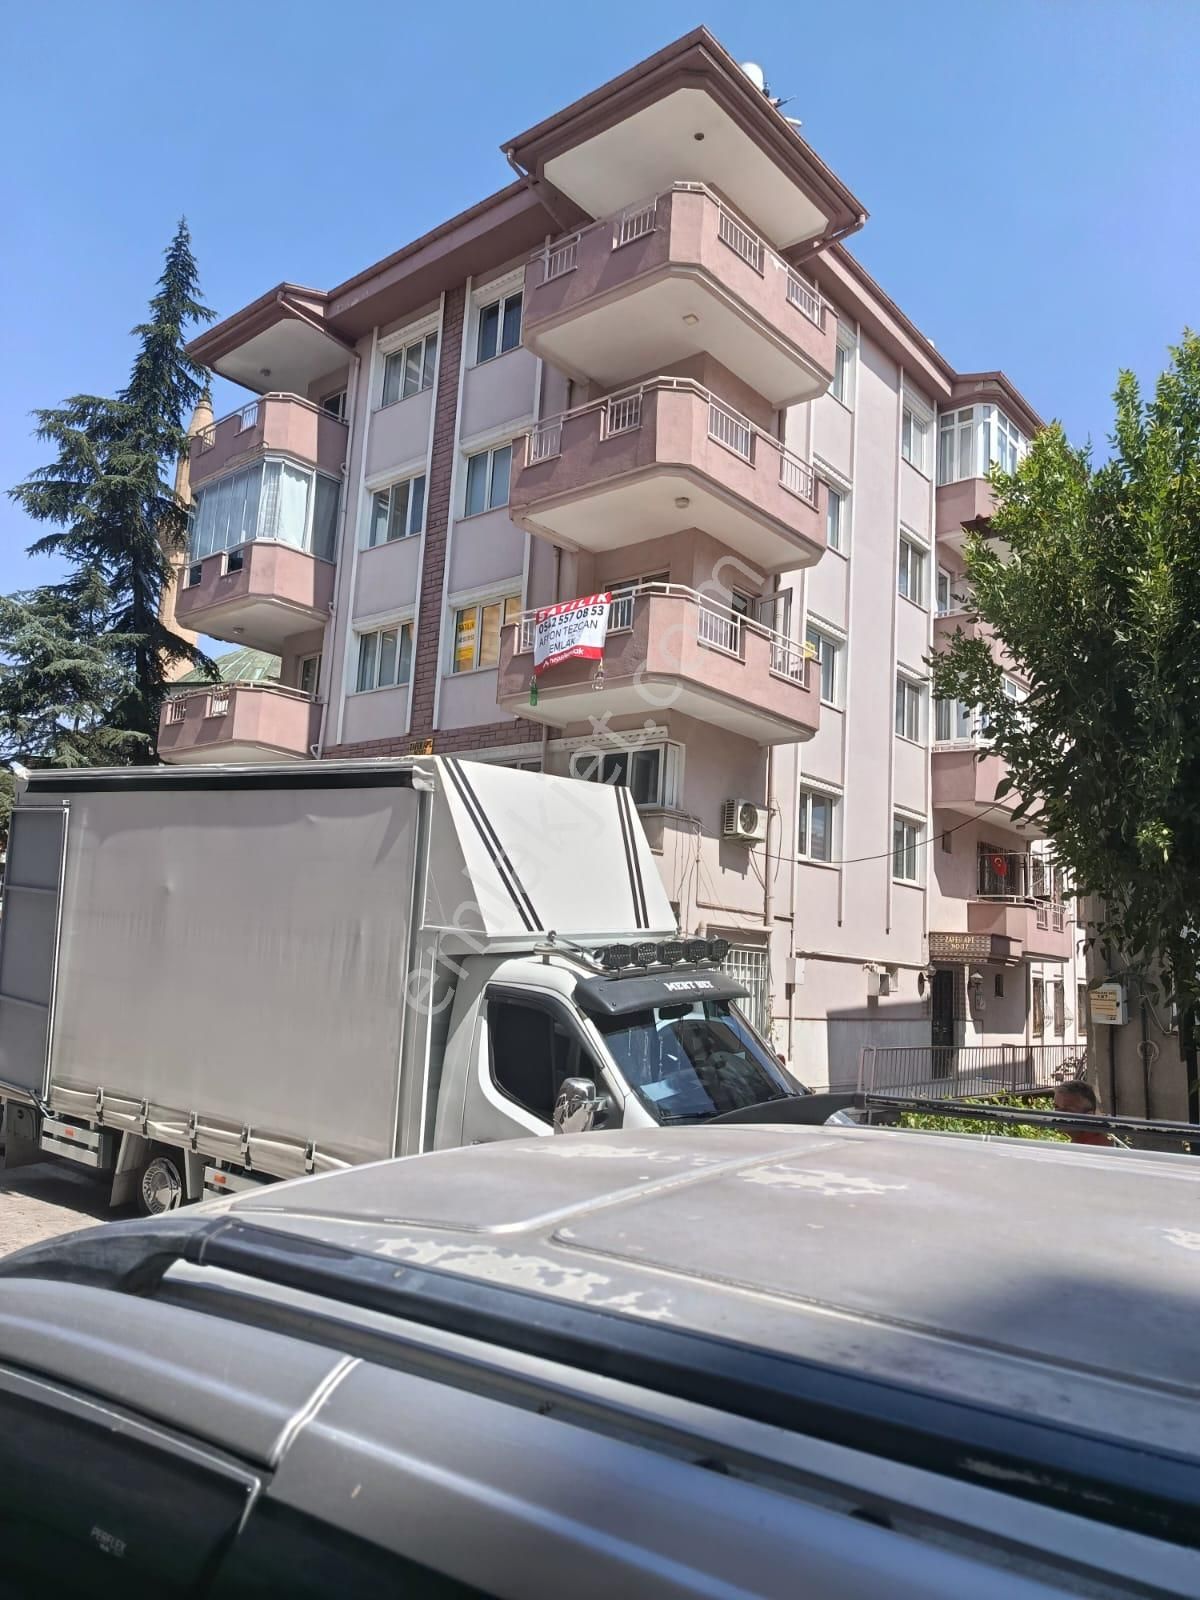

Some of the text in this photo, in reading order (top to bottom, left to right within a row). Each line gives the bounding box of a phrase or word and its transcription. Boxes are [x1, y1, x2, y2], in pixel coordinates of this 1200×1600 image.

[538, 593, 609, 621] SATILIK
[558, 611, 575, 625] 557
[576, 607, 589, 620] 08
[590, 605, 604, 616] 53
[563, 619, 598, 636] TEZCAN
[549, 637, 576, 654] EMLAK
